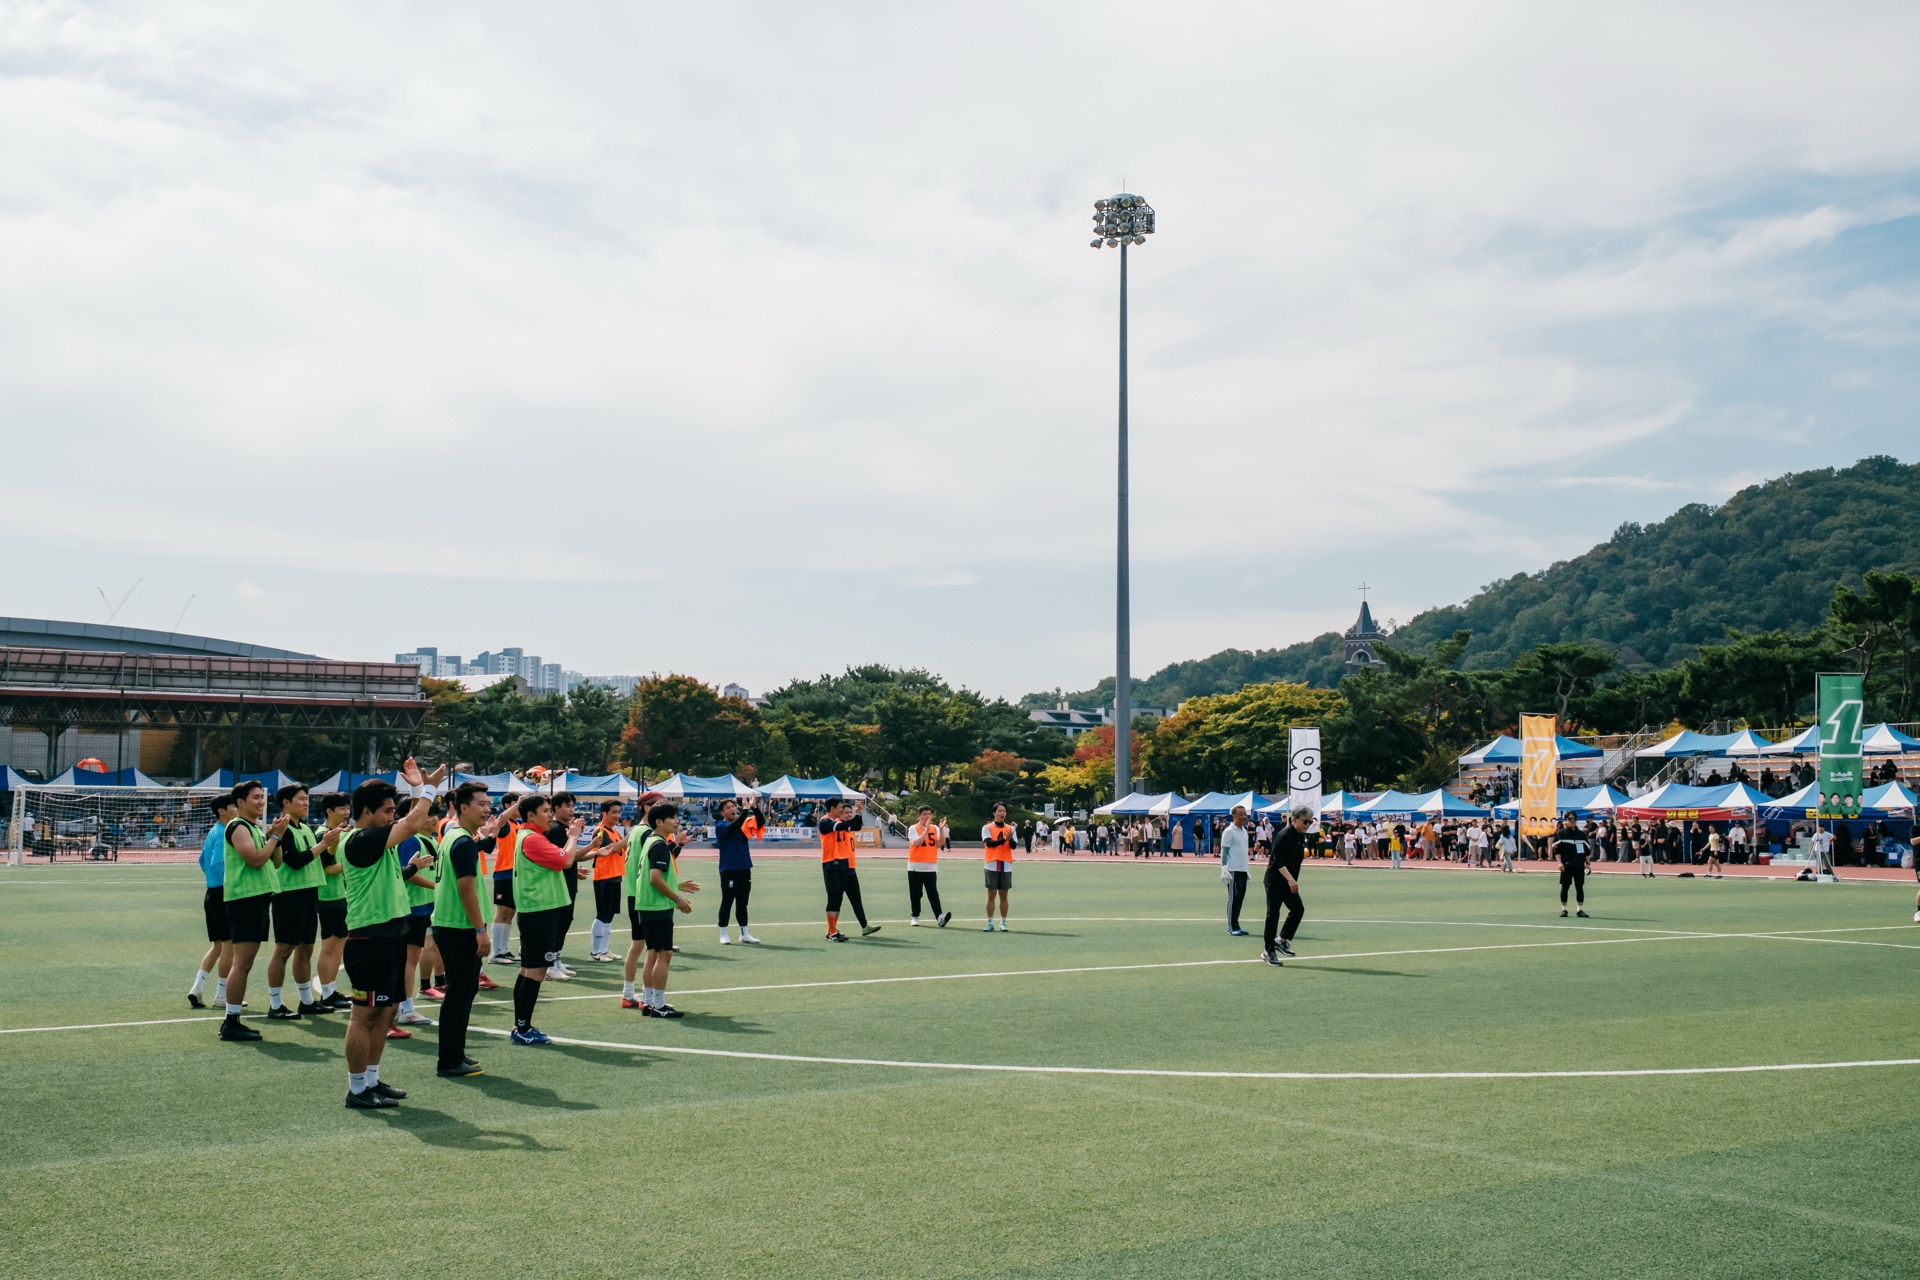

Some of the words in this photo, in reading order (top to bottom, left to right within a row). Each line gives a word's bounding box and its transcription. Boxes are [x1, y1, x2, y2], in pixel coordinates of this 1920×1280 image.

[1820, 700, 1863, 758] 1
[1290, 748, 1322, 791] 8
[1522, 736, 1557, 787] 7
